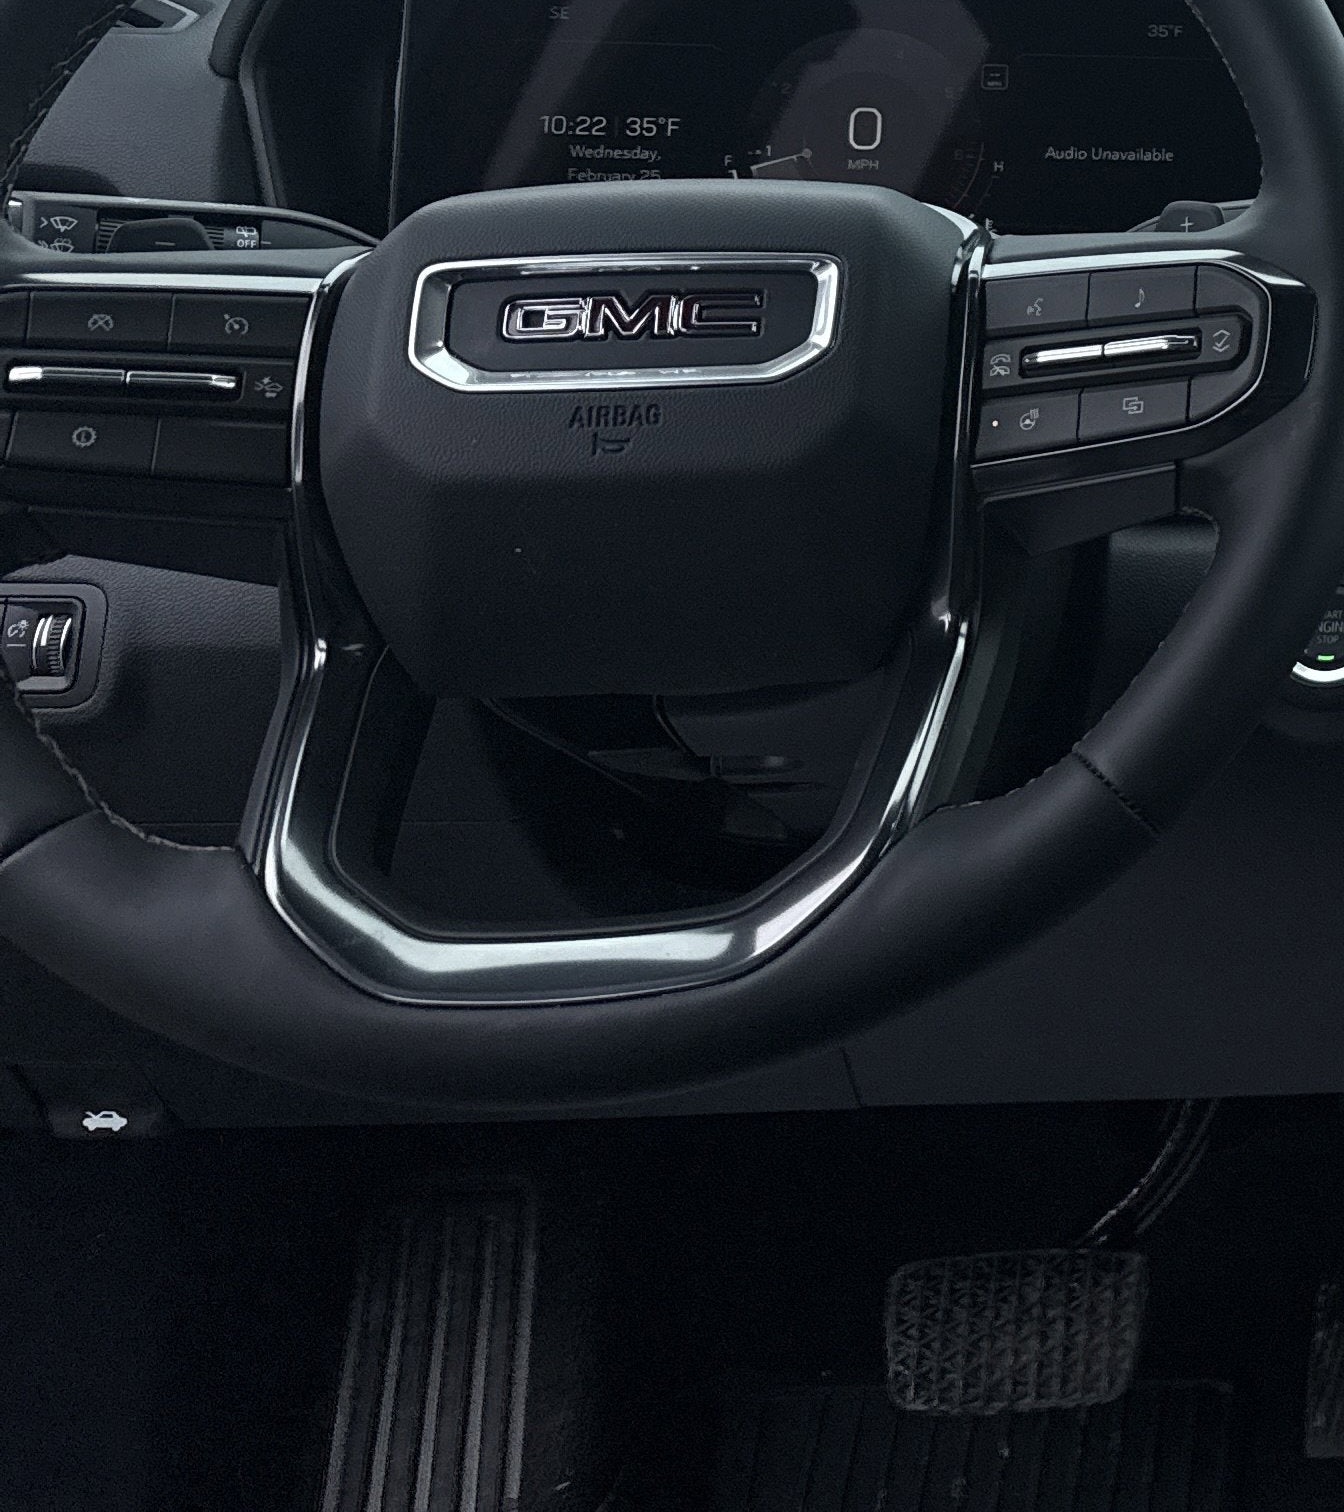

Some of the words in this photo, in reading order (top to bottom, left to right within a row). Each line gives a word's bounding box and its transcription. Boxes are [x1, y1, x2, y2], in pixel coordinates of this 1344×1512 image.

[539, 115, 607, 136] 10:22
[625, 117, 681, 137] 35°F
[848, 107, 882, 150] 0
[569, 144, 662, 163] Wednesday,
[1045, 146, 1088, 161] Audio
[1091, 146, 1175, 162] Unavailable
[848, 159, 880, 170] MPH
[236, 239, 257, 248] OFF
[502, 290, 763, 341] GMC
[567, 403, 661, 429] AIRBAG
[1325, 610, 1344, 619] ART
[1316, 635, 1339, 644] STOP
